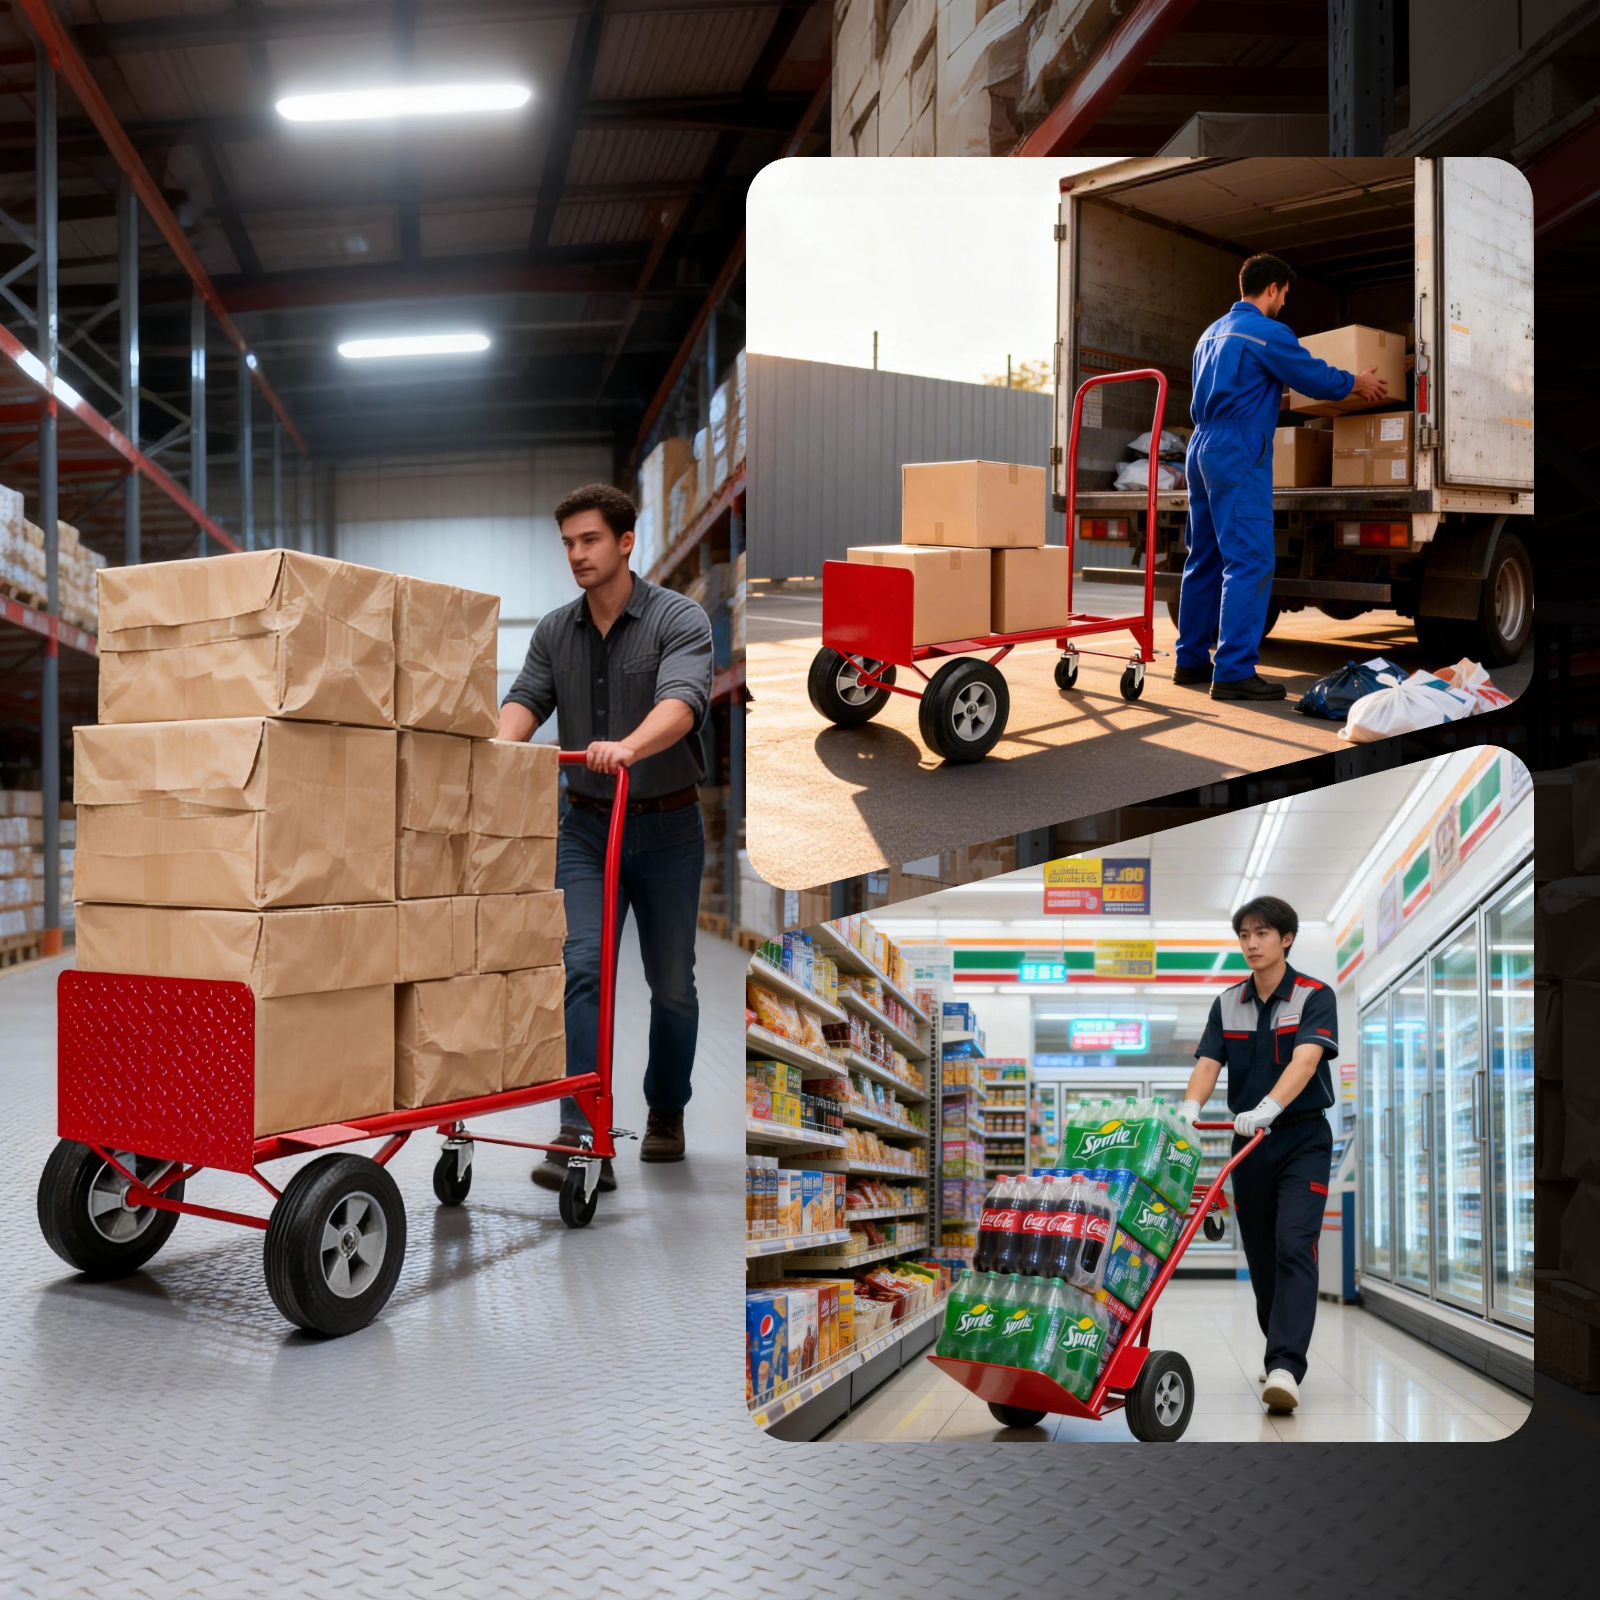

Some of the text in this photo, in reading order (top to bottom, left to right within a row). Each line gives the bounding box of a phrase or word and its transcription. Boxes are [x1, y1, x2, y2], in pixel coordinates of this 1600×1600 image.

[1081, 1126, 1130, 1155] Sprite
[955, 1310, 994, 1332] Sprite
[1002, 1314, 1031, 1334] Sprite
[1063, 1325, 1099, 1348] Sprite
